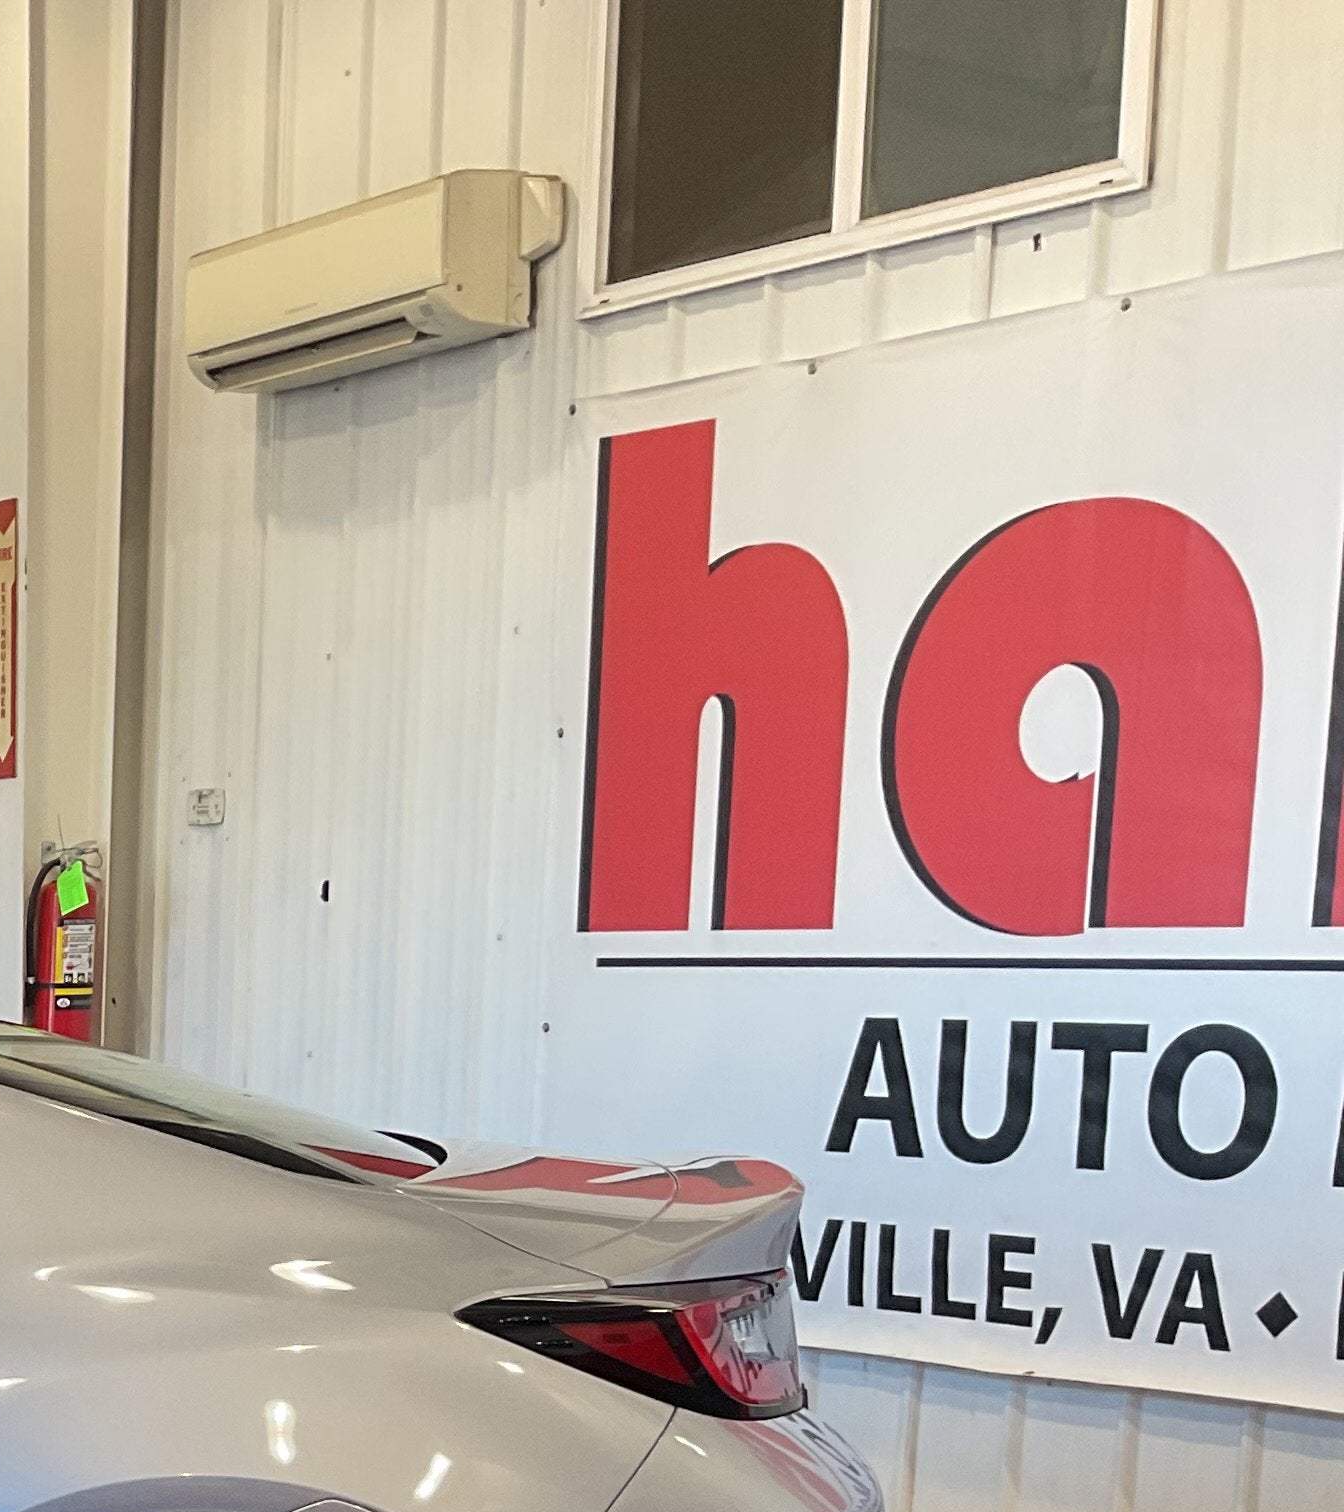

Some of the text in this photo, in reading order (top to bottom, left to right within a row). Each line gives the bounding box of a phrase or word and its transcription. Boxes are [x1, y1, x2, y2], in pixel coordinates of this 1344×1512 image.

[0, 582, 7, 719] EXTINGUISHER
[825, 1015, 1279, 1182] AUTO
[1091, 1242, 1231, 1352] VA
